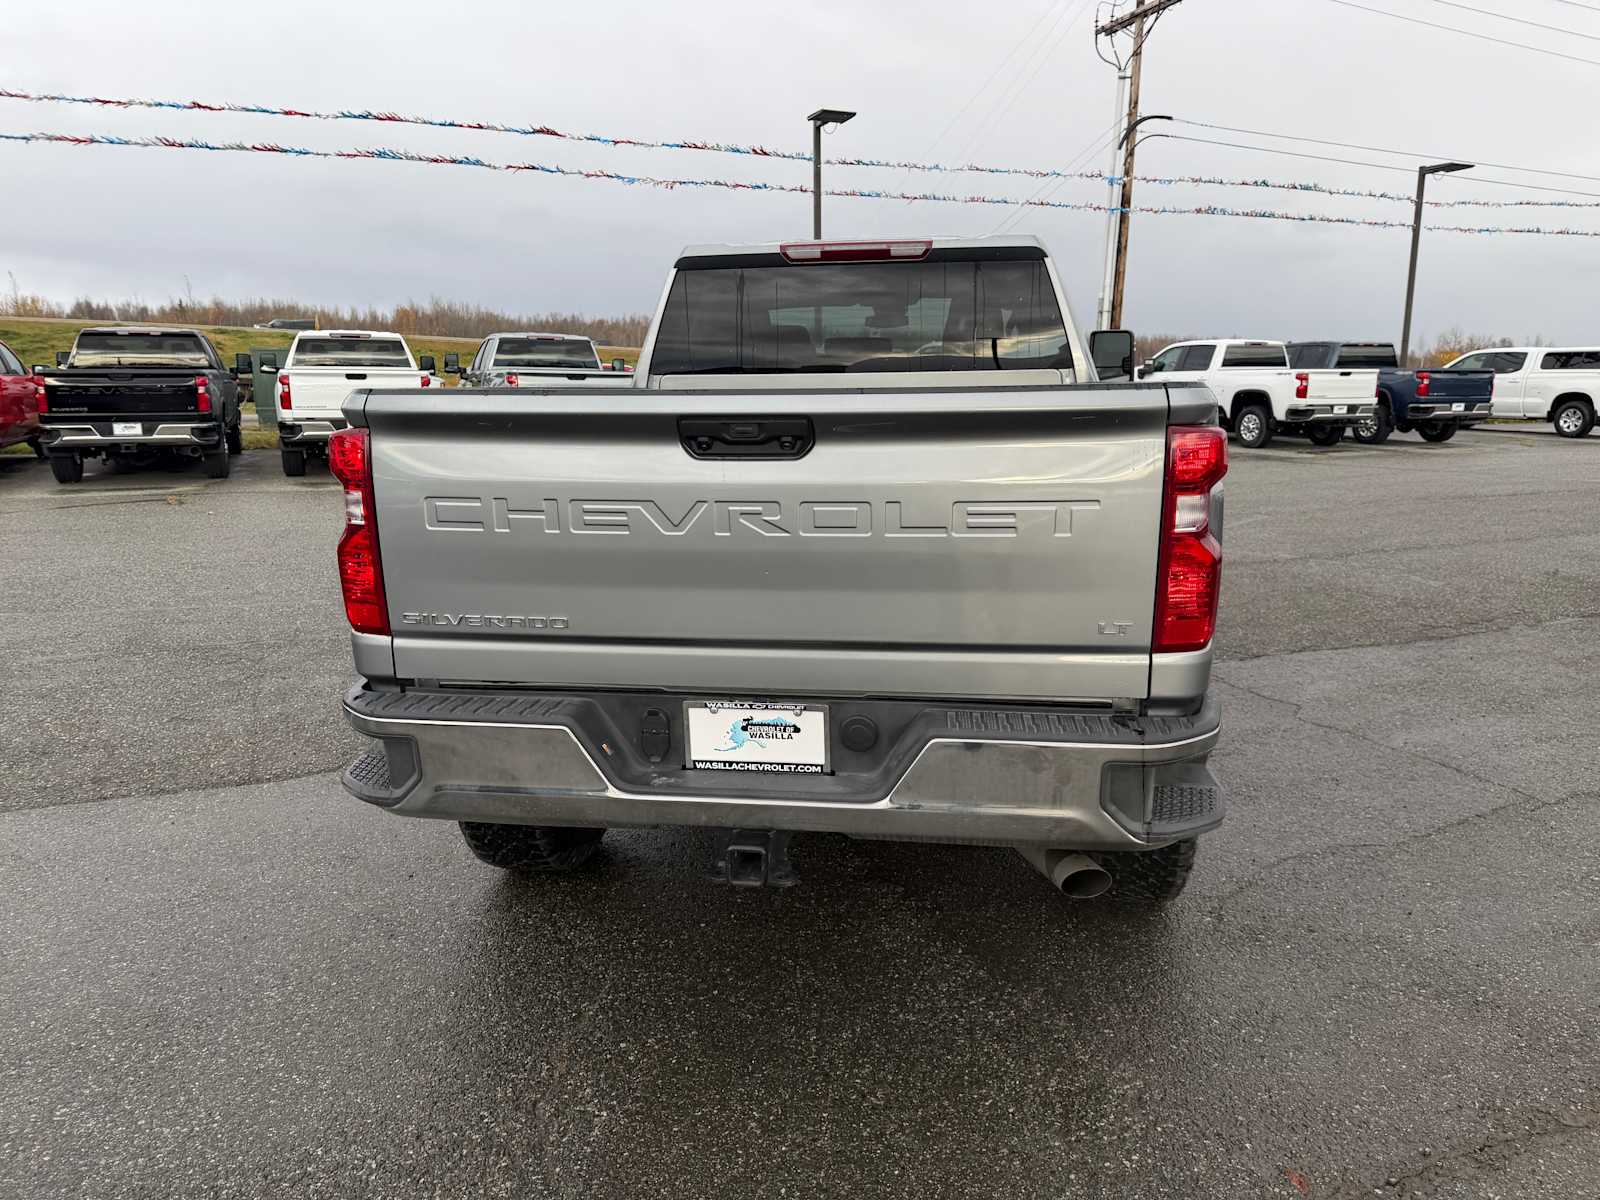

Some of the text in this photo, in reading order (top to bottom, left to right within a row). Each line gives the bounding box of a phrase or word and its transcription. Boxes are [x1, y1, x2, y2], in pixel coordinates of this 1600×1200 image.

[424, 497, 1101, 539] CHEVROLET
[402, 612, 568, 629] SILVERADO
[1097, 621, 1133, 636] LT
[695, 761, 821, 773] WASILLACHEVROLET.COM
